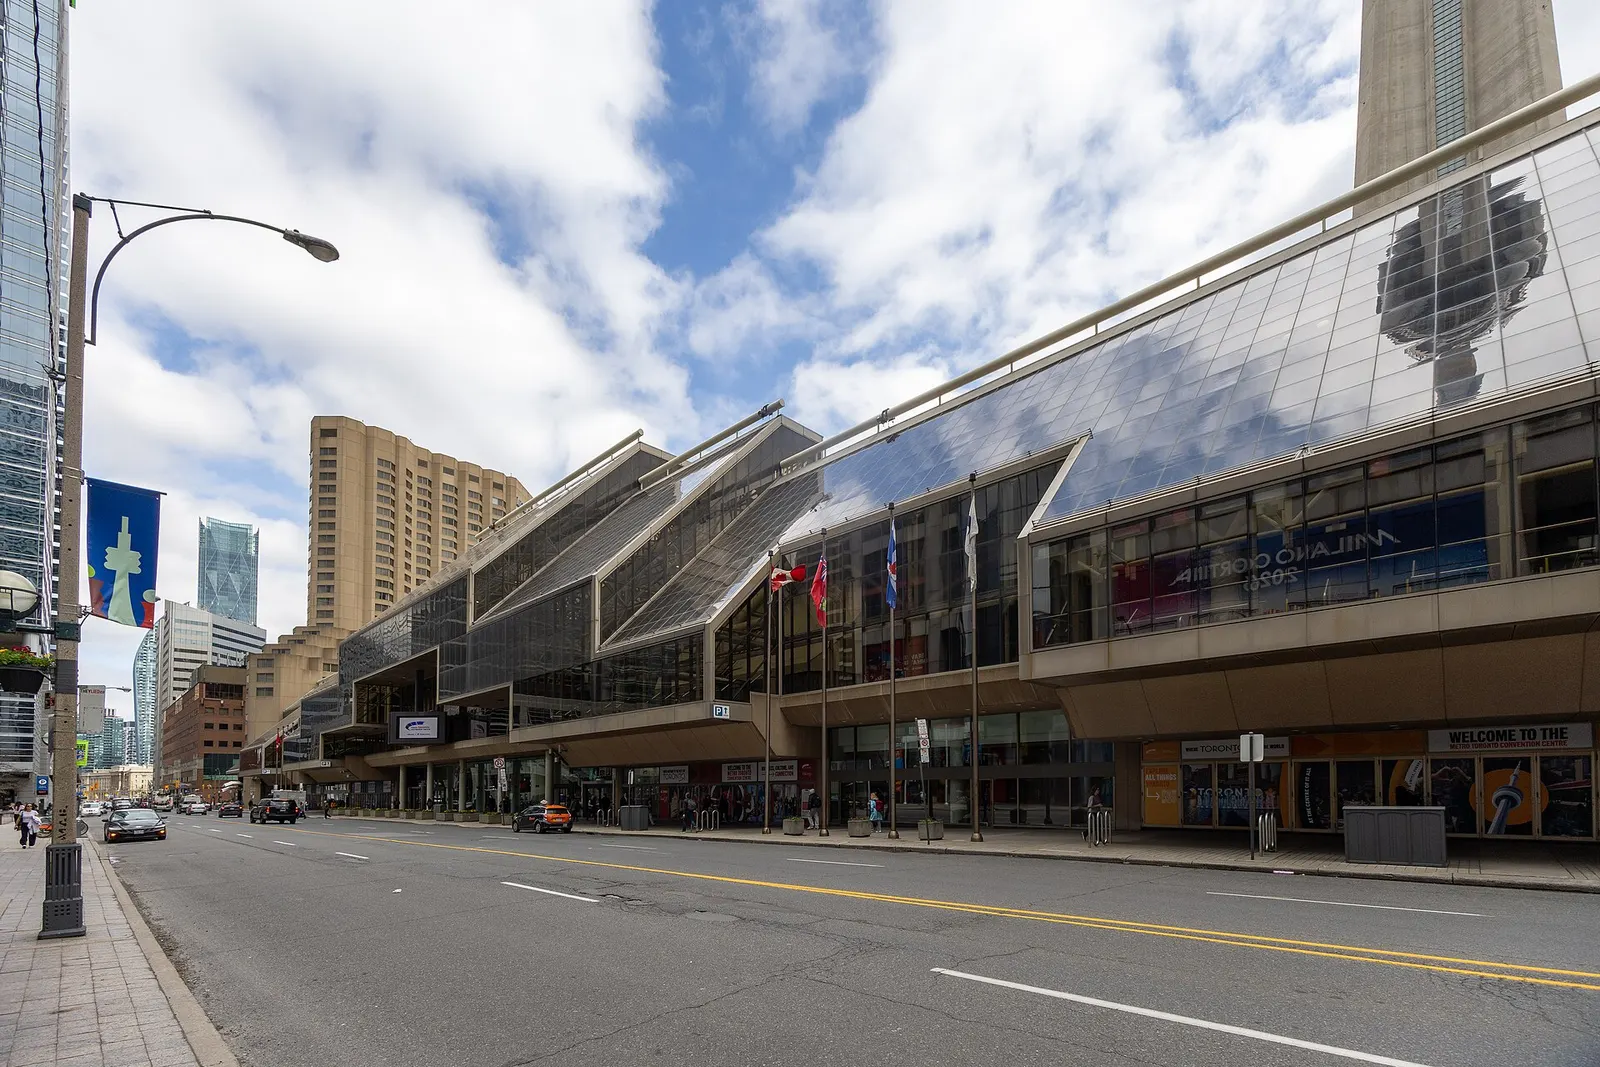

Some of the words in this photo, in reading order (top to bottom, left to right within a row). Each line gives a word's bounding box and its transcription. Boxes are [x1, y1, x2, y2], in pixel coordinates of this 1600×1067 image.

[1449, 729, 1516, 743] WELCOME
[1519, 728, 1537, 740] TO
[1539, 727, 1569, 740] THE
[1500, 740, 1540, 748] CONVENTION
[1541, 739, 1568, 747] CENTRE
